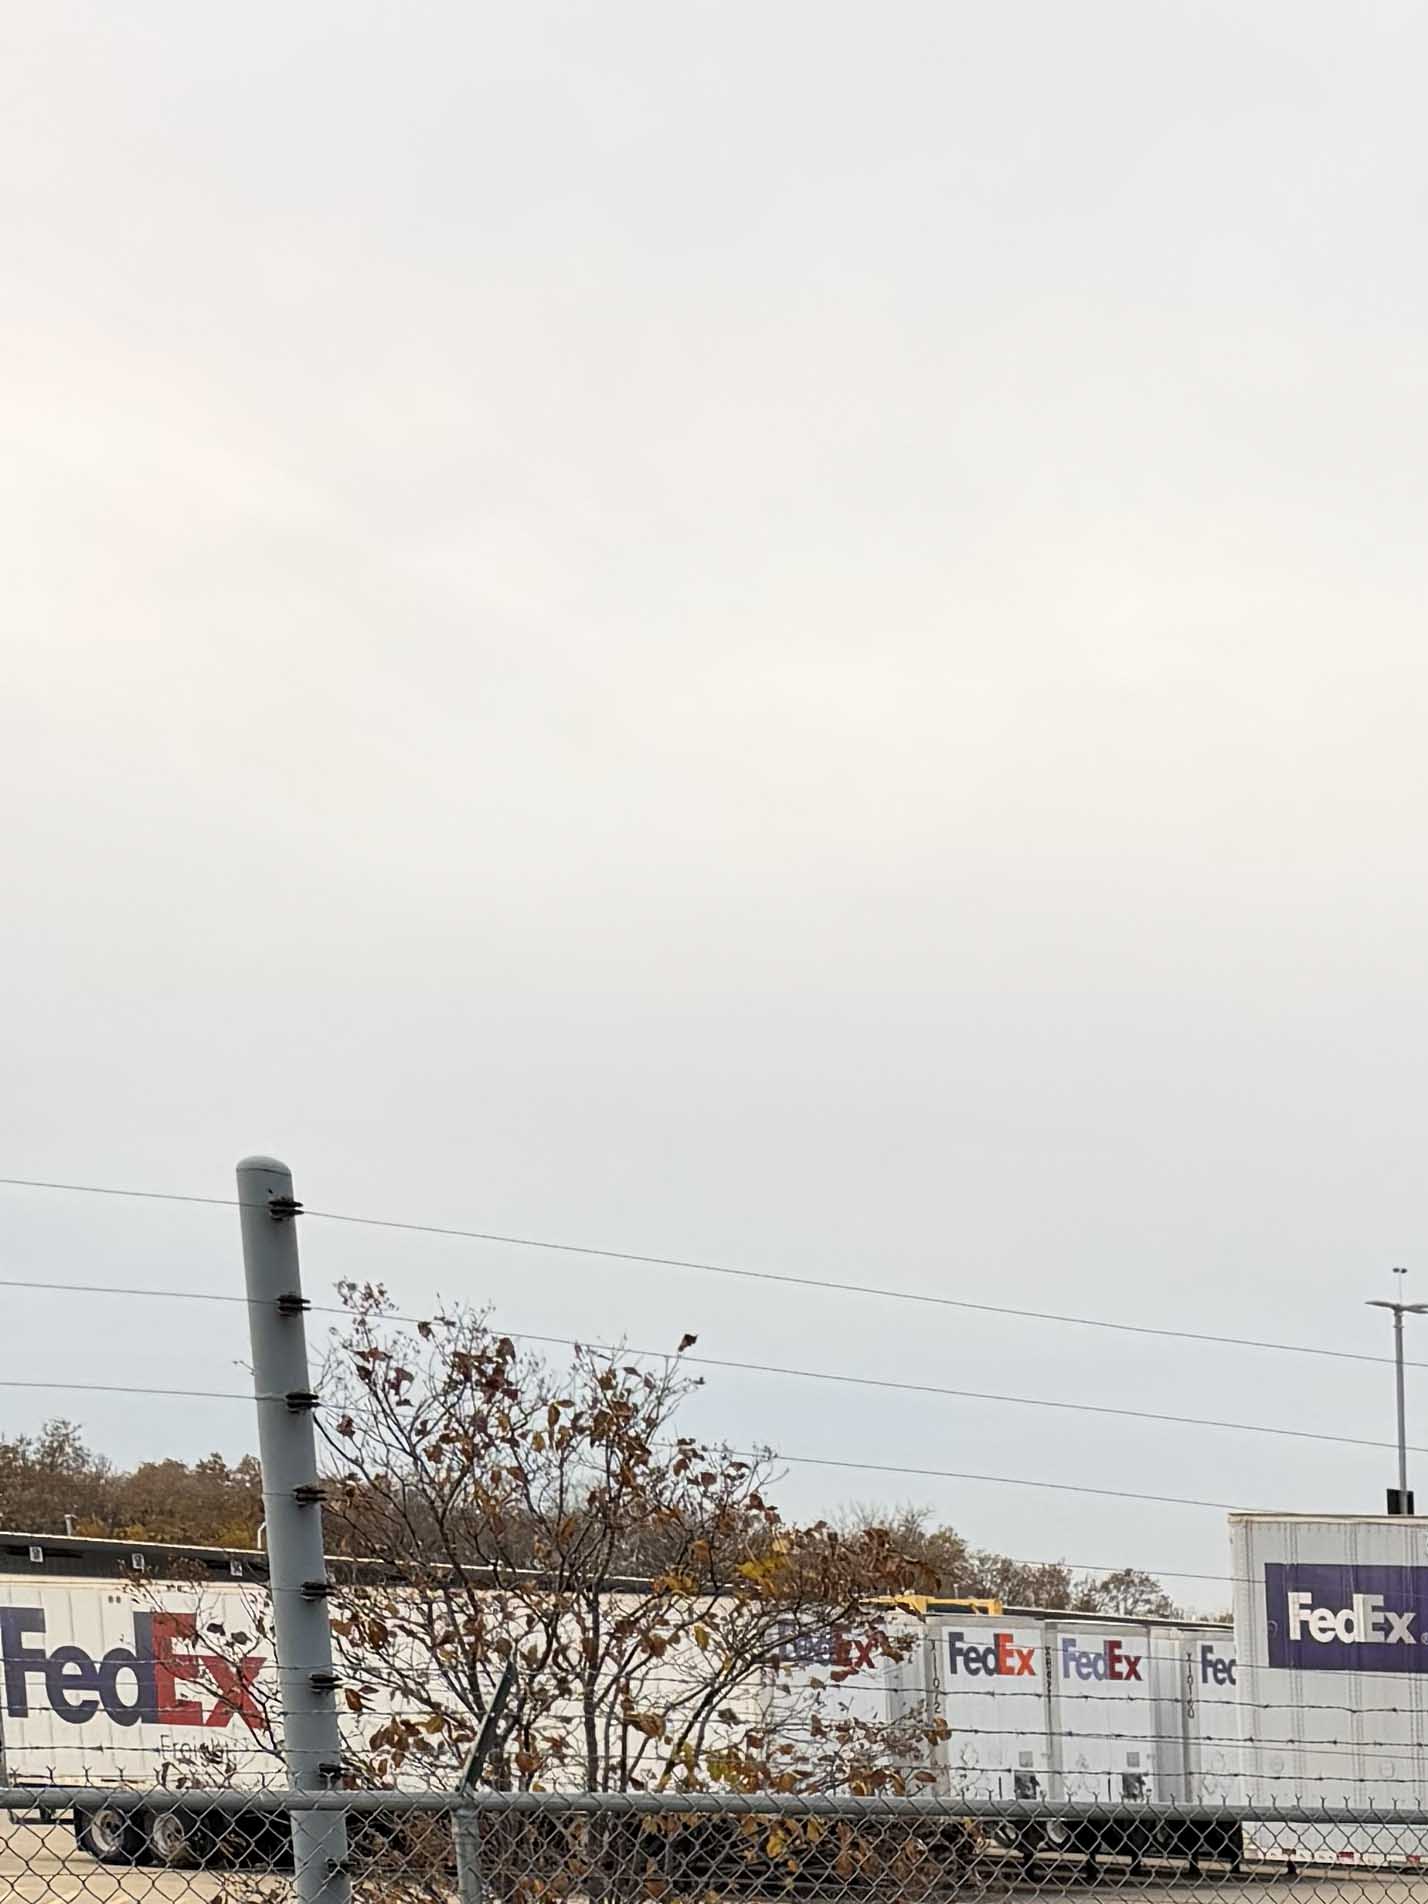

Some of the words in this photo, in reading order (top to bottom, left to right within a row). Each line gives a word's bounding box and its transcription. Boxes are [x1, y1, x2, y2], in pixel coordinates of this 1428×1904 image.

[1288, 1591, 1417, 1644] FedEx
[0, 1606, 268, 1729] FedEx
[948, 1631, 1037, 1677] FedEx
[1062, 1637, 1143, 1681] FedEx
